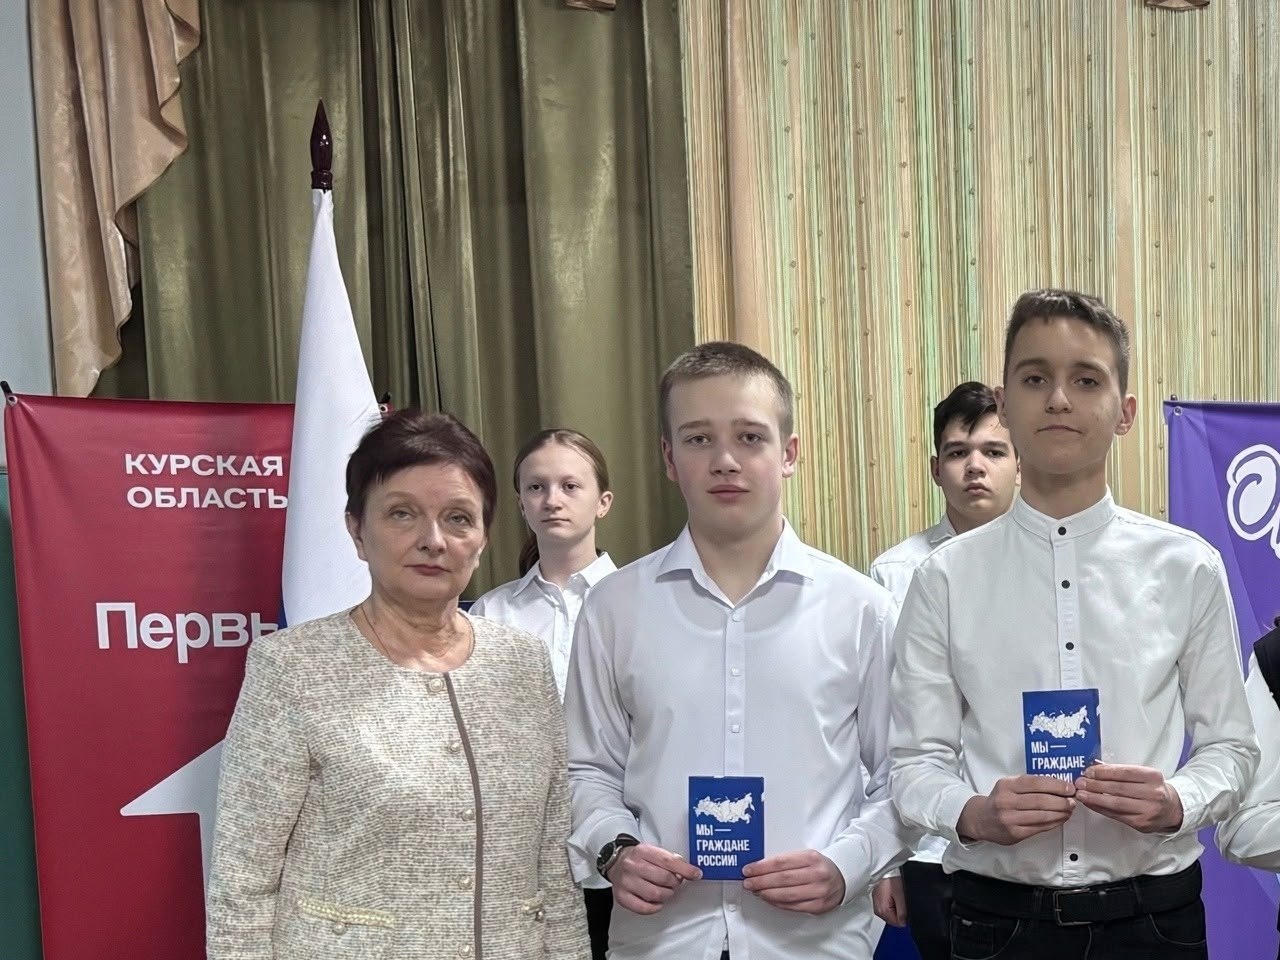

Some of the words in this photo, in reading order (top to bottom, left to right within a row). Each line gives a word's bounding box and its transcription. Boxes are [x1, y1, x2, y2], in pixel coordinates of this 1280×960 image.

[124, 453, 284, 477] КУРСКАЯ
[126, 486, 289, 509] ОБЛАСТЬ
[1030, 741, 1049, 754] МЫ
[1031, 755, 1086, 770] ГРАЖДАНЕ
[695, 824, 714, 837] МЫ
[696, 839, 751, 853] ГРАЖДАНЕ
[697, 854, 738, 867] РОССИИ!
